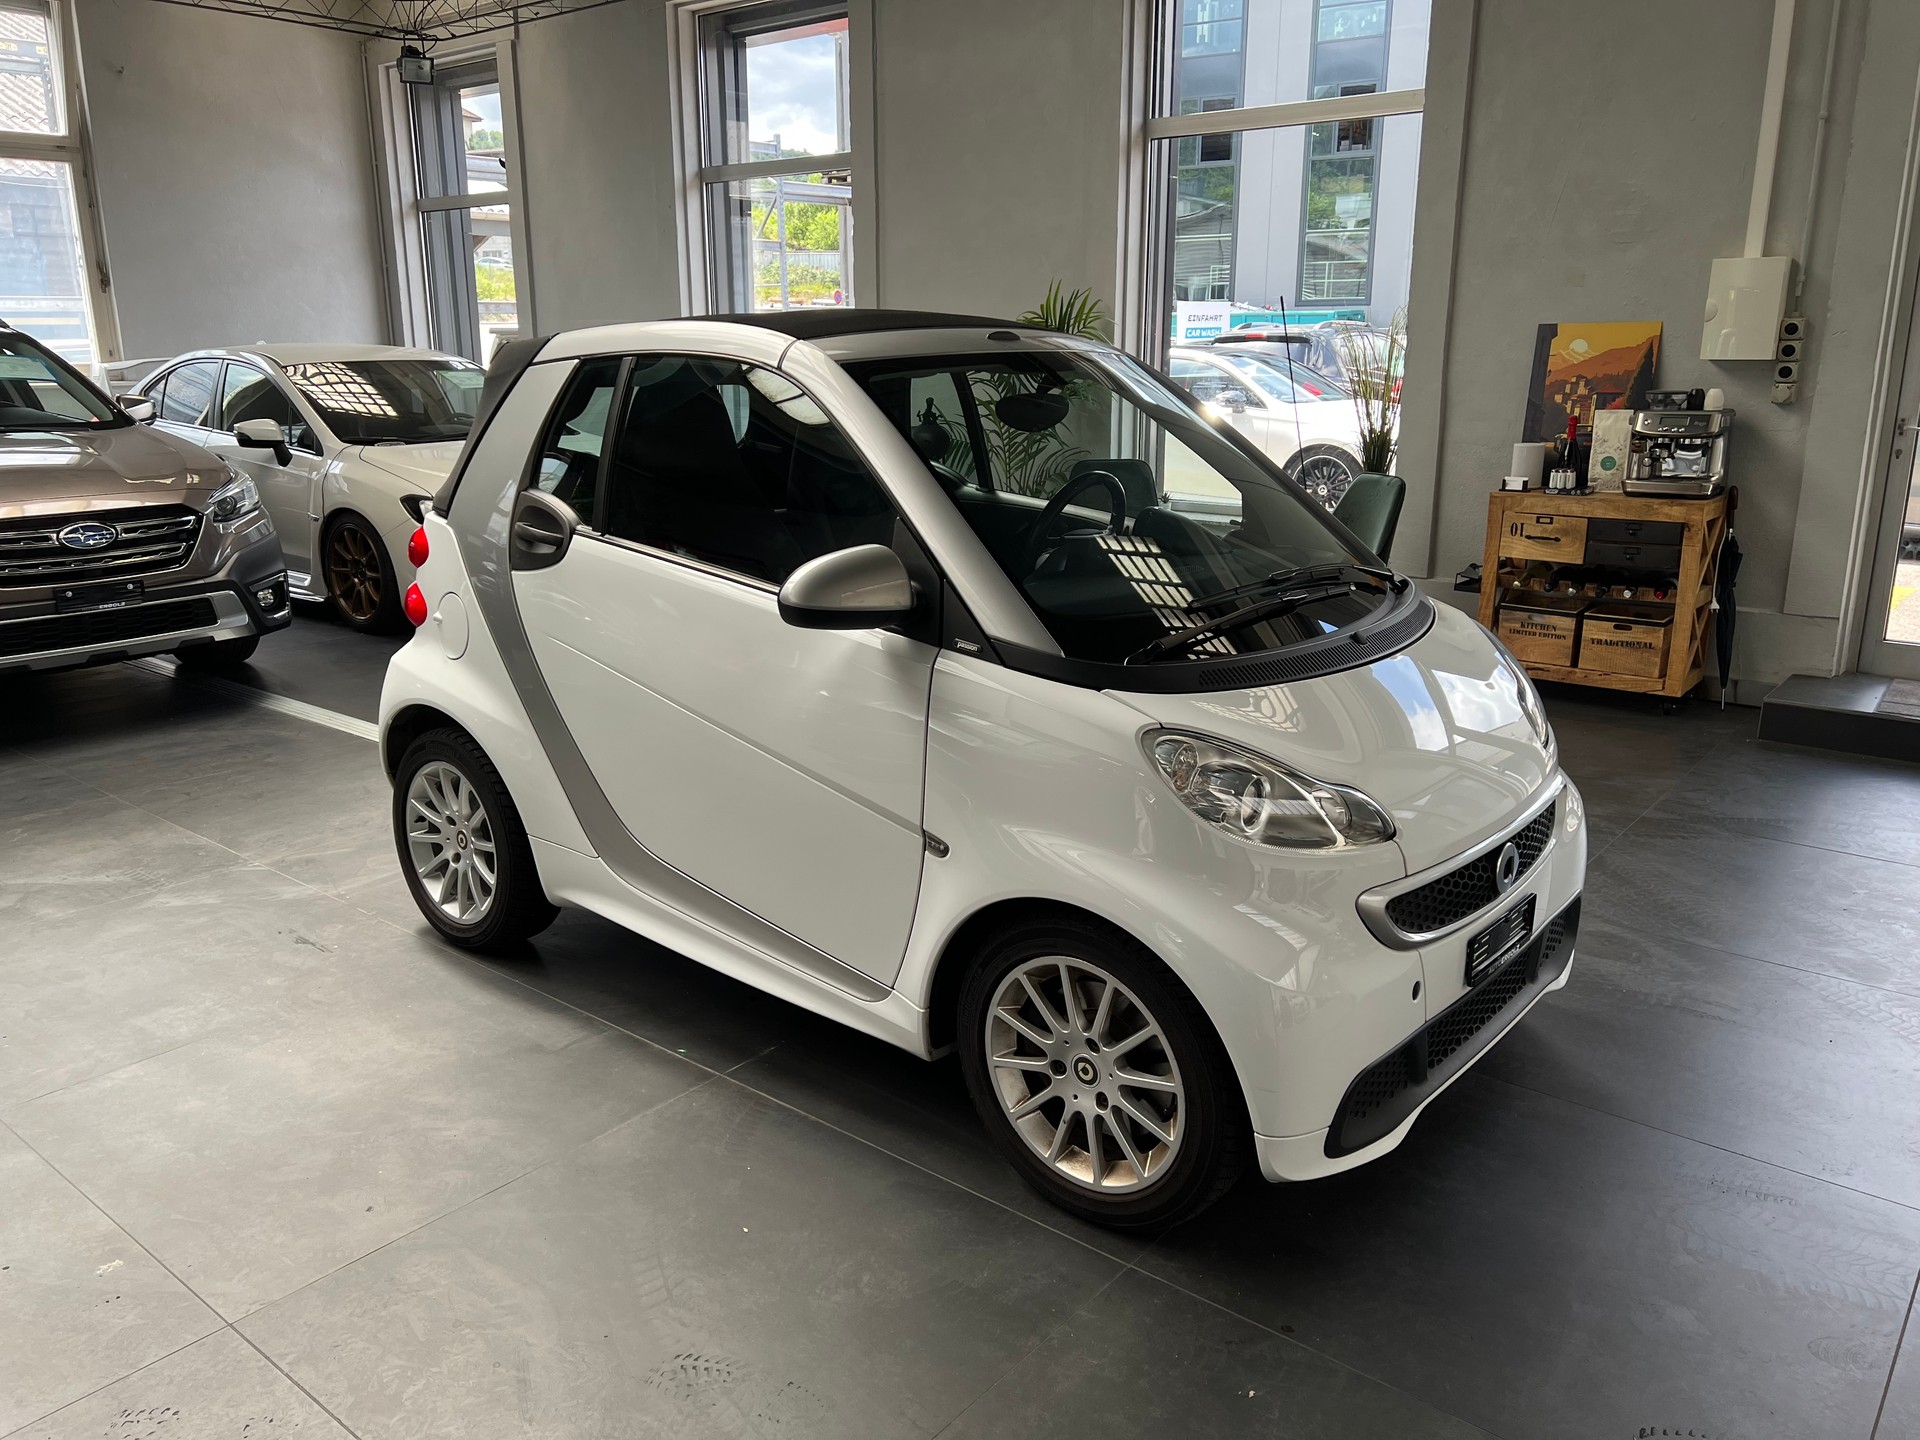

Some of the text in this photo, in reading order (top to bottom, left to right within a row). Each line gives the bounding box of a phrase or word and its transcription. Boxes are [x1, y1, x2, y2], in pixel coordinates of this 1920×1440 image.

[1187, 314, 1223, 322] EINFAHRT
[1186, 328, 1221, 337] CAR WASH
[1520, 621, 1558, 632] KITCHEN
[1509, 628, 1567, 640] LIMITED EDITION
[957, 641, 978, 652] passion
[1590, 637, 1655, 650] TRADITIONAL
